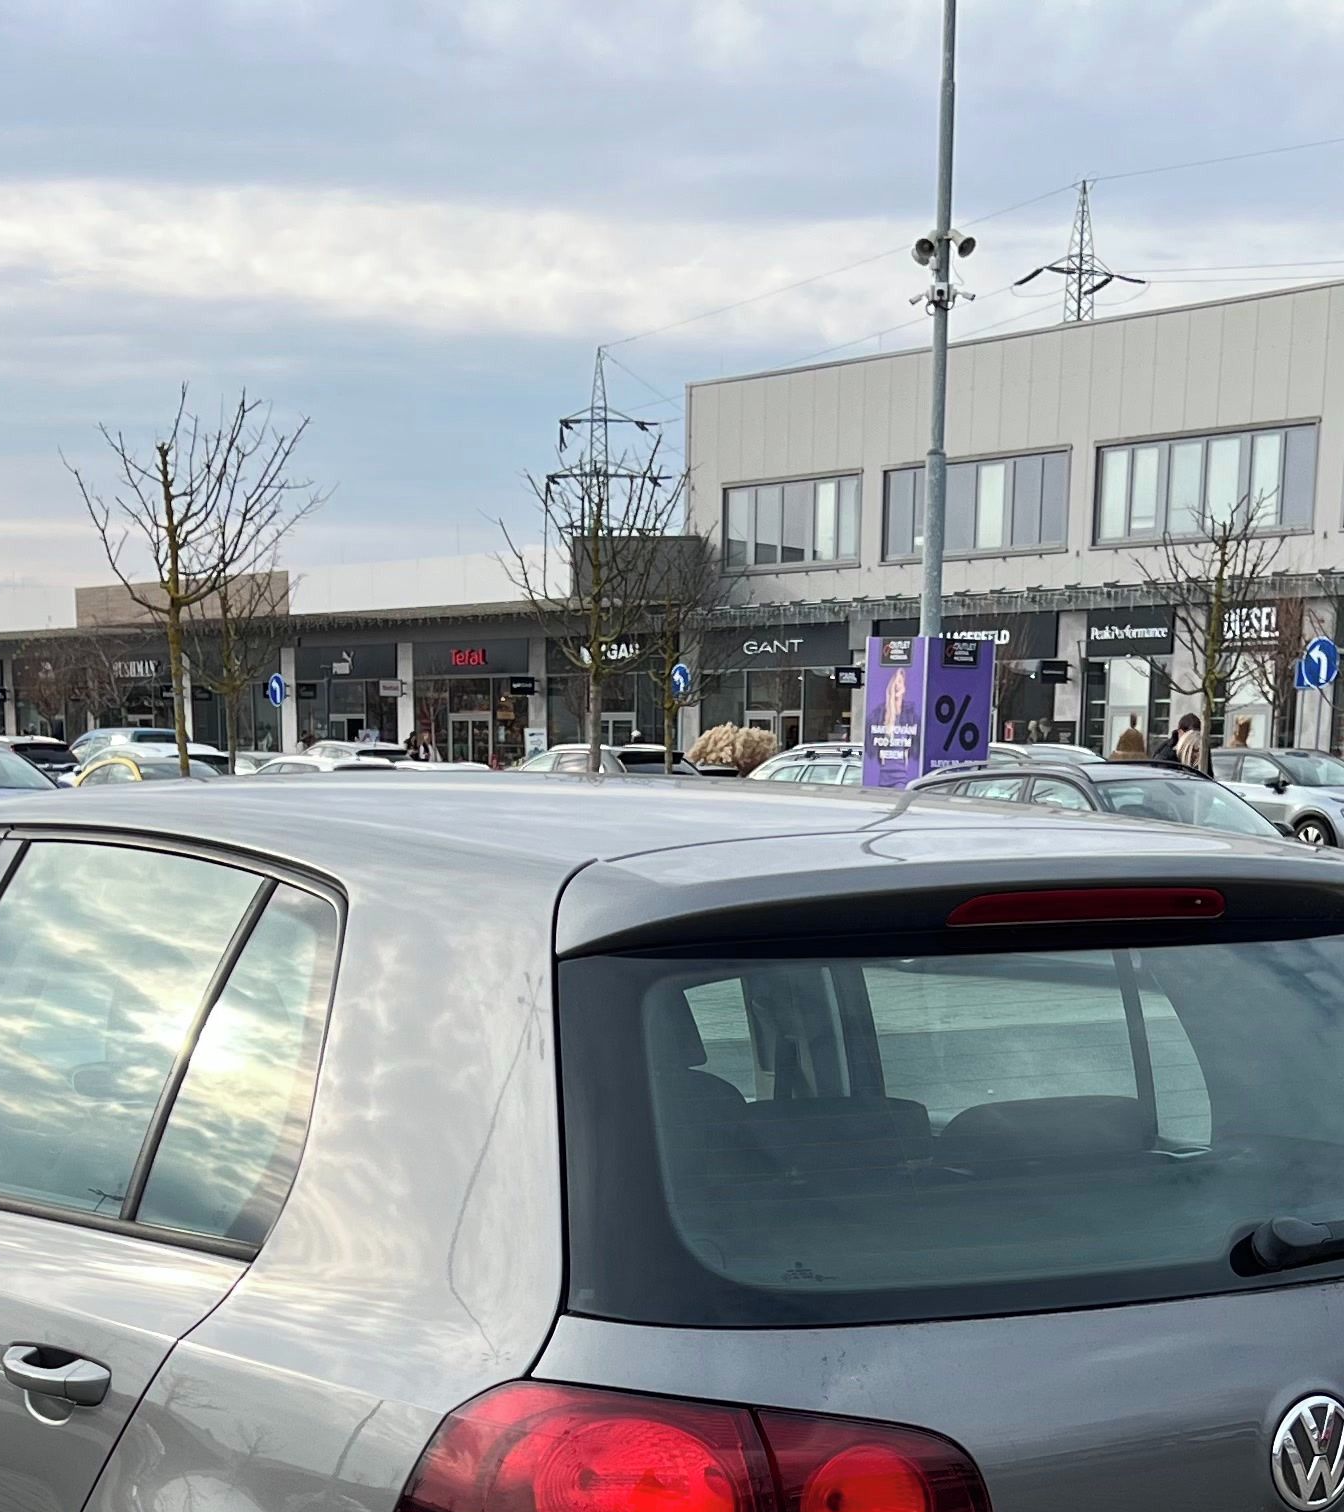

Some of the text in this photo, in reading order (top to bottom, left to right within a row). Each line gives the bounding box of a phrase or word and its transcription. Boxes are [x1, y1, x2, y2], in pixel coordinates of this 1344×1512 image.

[1222, 606, 1280, 639] DIESEL
[743, 640, 804, 655] GANT
[451, 648, 486, 665] Tefal
